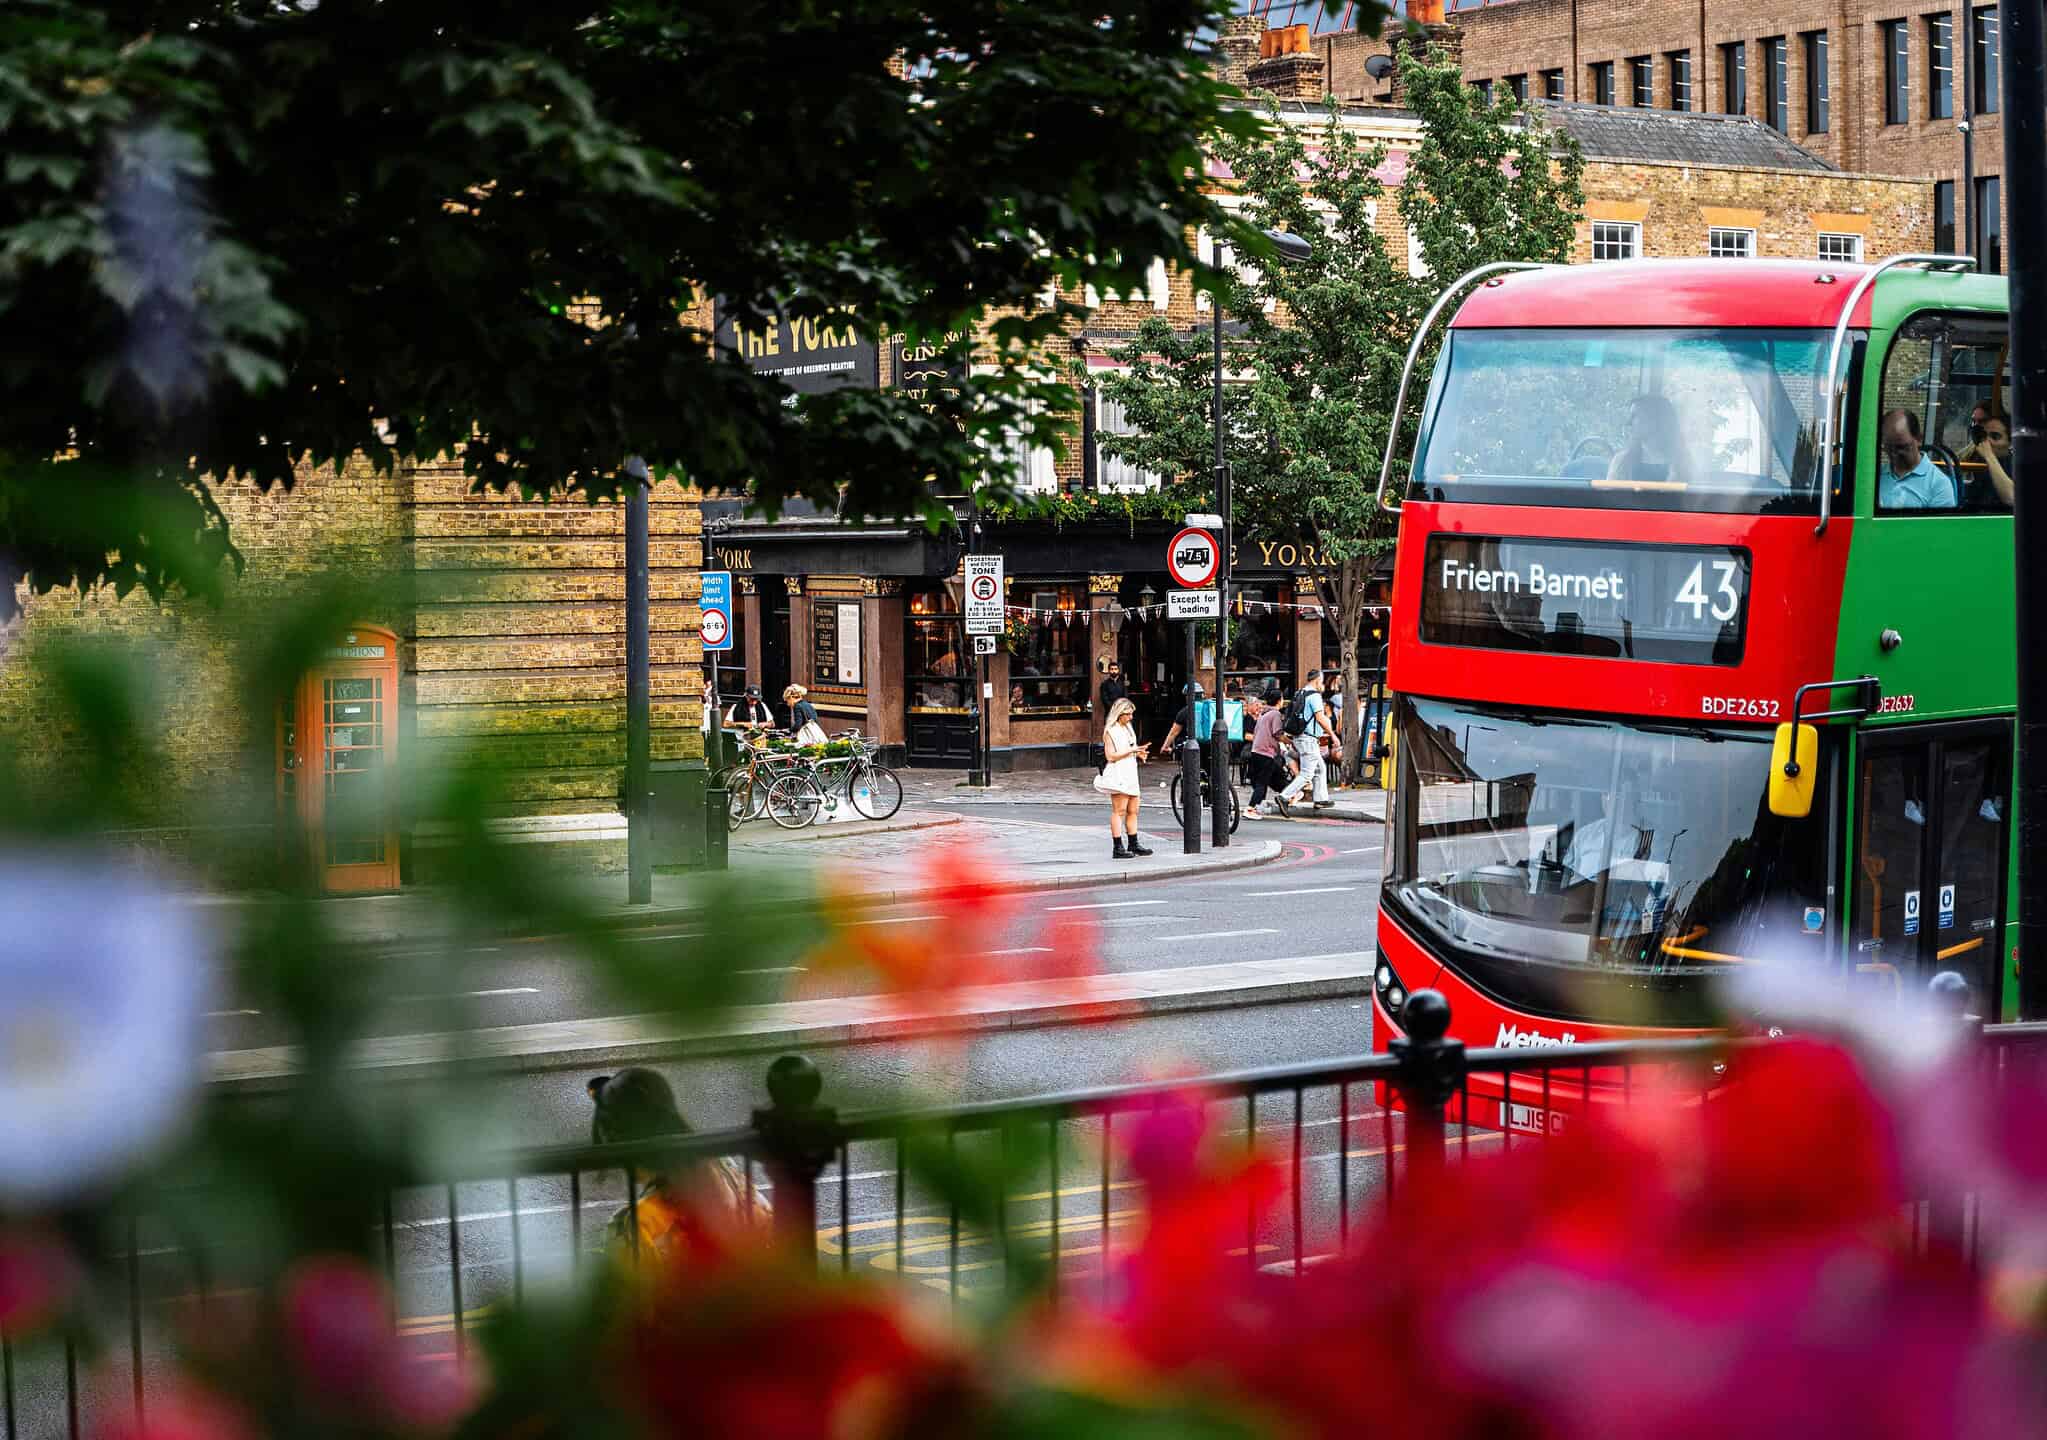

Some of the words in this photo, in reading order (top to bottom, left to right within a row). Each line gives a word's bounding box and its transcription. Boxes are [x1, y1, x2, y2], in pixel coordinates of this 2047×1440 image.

[716, 547, 752, 569] YORK
[1259, 541, 1337, 566] YORK
[971, 567, 997, 575] ZONE
[1171, 594, 1201, 604] Except
[1204, 594, 1217, 602] for
[1441, 559, 1520, 594] Friern
[1529, 563, 1625, 600] Barnet
[1674, 560, 1739, 622] 43
[1179, 604, 1210, 614] loading
[1701, 696, 1780, 718] BDE2632
[1877, 695, 1915, 713] DE2632
